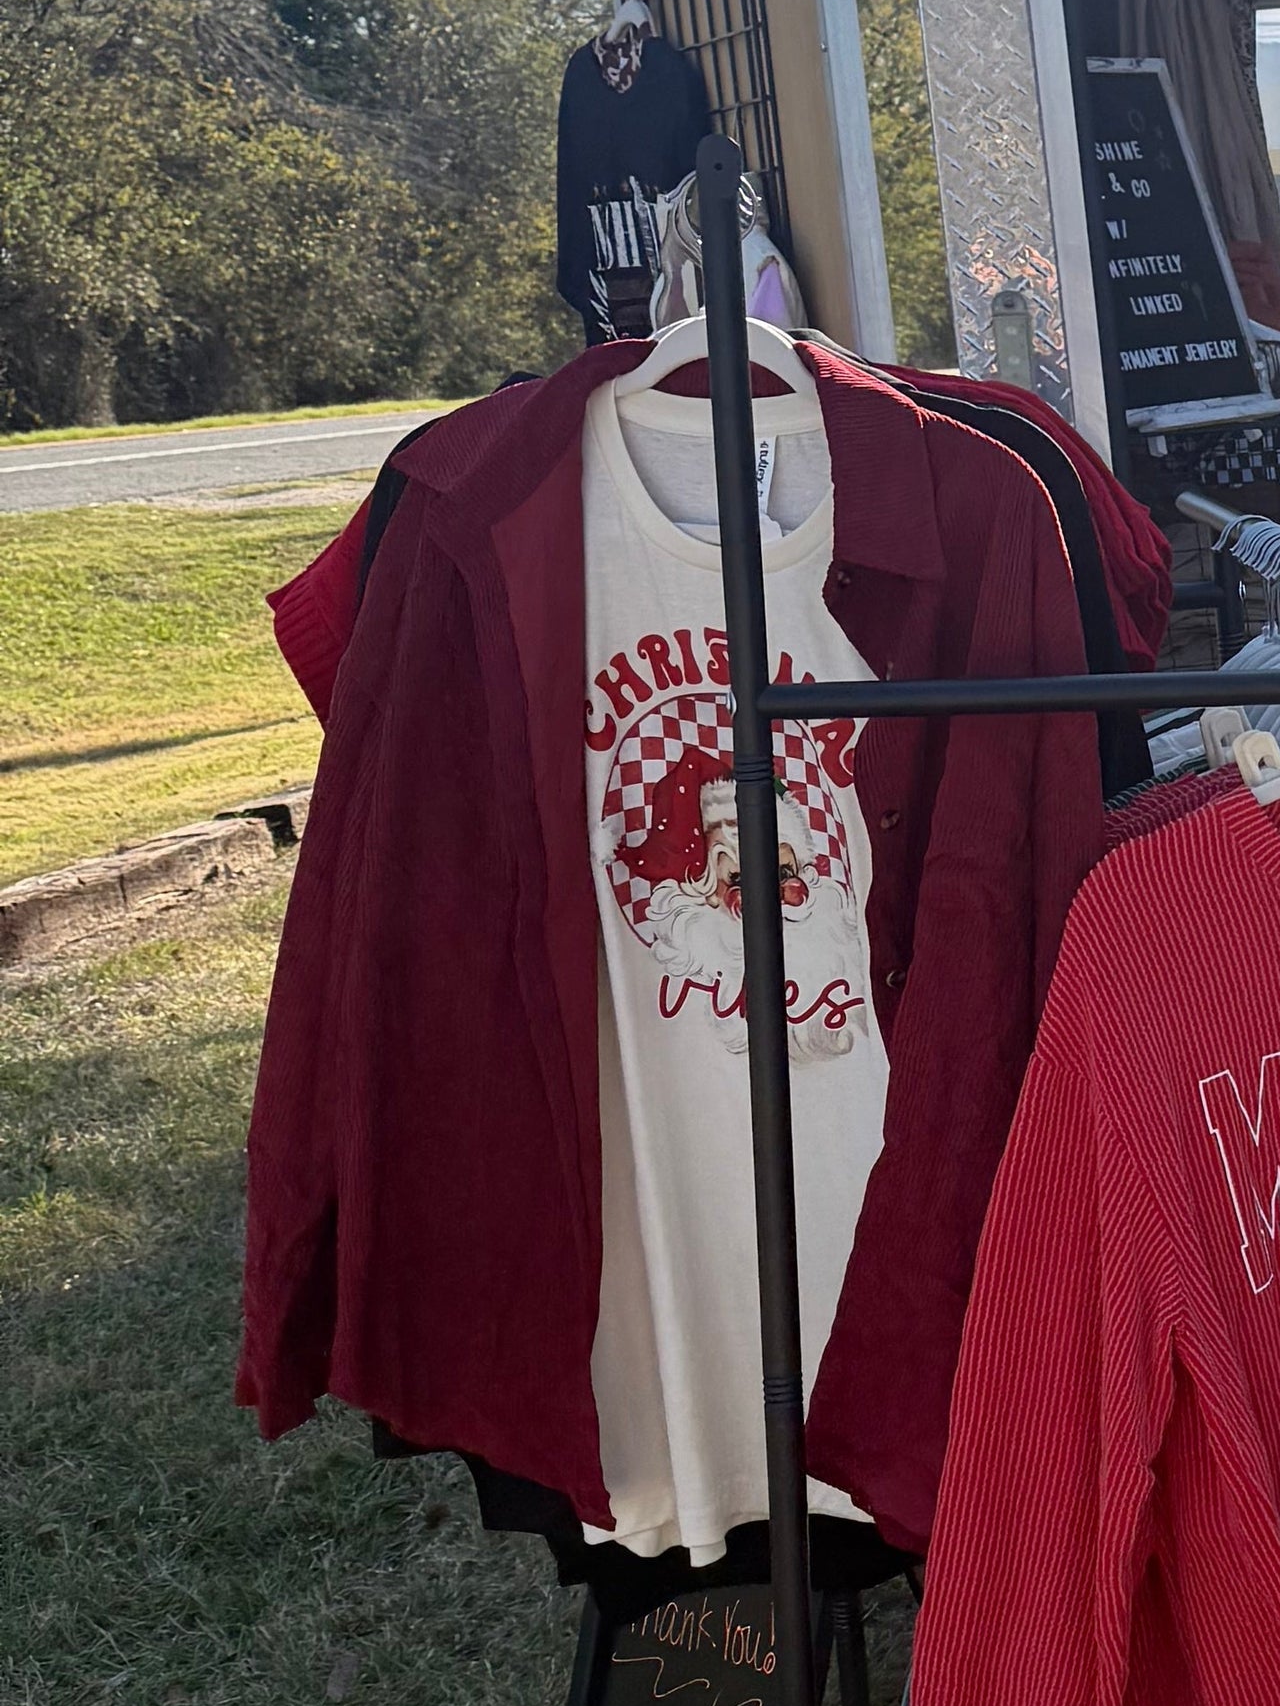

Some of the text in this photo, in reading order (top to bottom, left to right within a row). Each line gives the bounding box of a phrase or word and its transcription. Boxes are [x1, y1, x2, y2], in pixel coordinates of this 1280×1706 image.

[1096, 141, 1144, 162] SHINE
[1108, 172, 1152, 198] & CO
[1105, 219, 1128, 241] W/
[1108, 254, 1183, 279] NFINITELY
[1129, 293, 1183, 316] LINKED
[1185, 339, 1239, 363] JEWELRY
[657, 969, 865, 1031] vies
